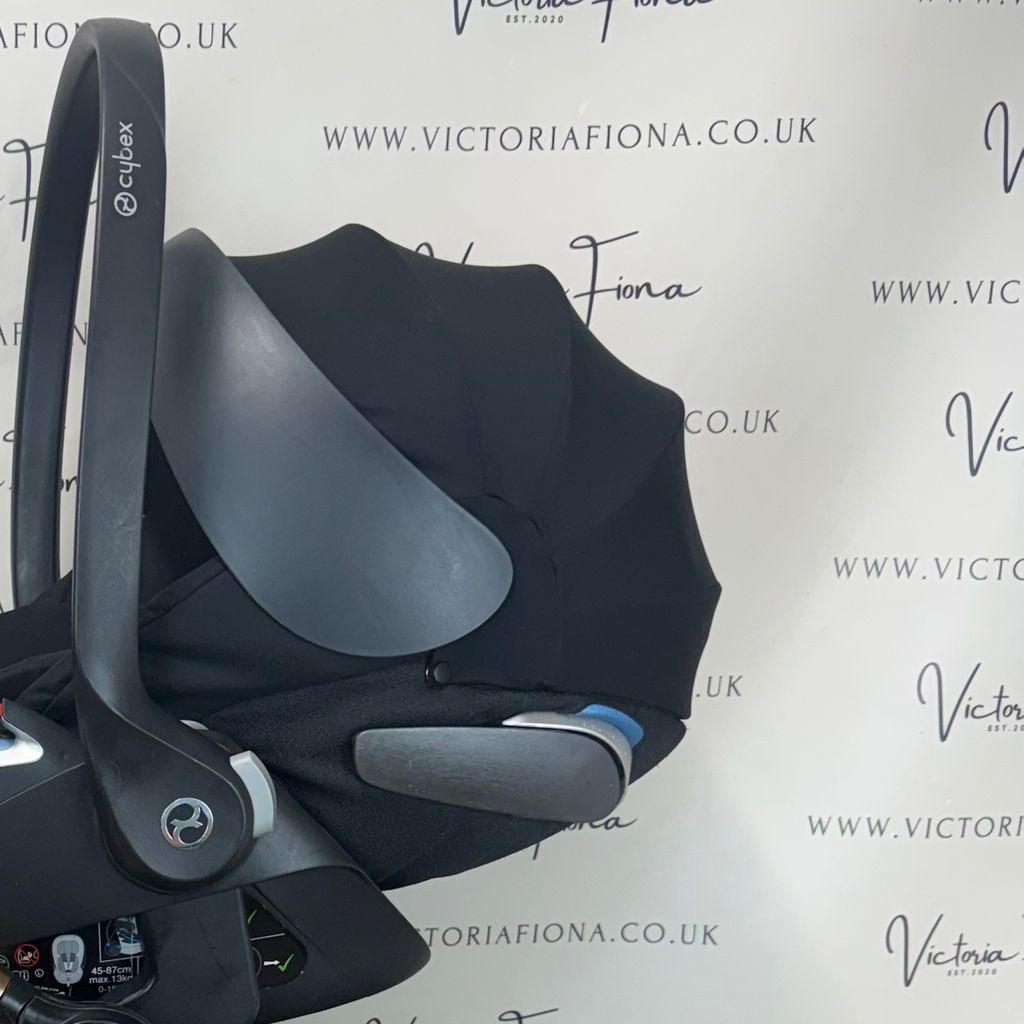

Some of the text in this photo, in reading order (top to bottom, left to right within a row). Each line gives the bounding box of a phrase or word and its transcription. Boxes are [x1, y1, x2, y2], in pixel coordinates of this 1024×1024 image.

[506, 15, 563, 23] EST.2020
[323, 117, 816, 152] WWW.VICTORIAFIONA.CO.UK
[112, 122, 141, 188] cybex
[570, 231, 702, 328] Fiona
[416, 922, 718, 947] TORIAFIONA.CO.UK
[886, 914, 1019, 987] Victoria
[91, 966, 132, 975] 45-87cm
